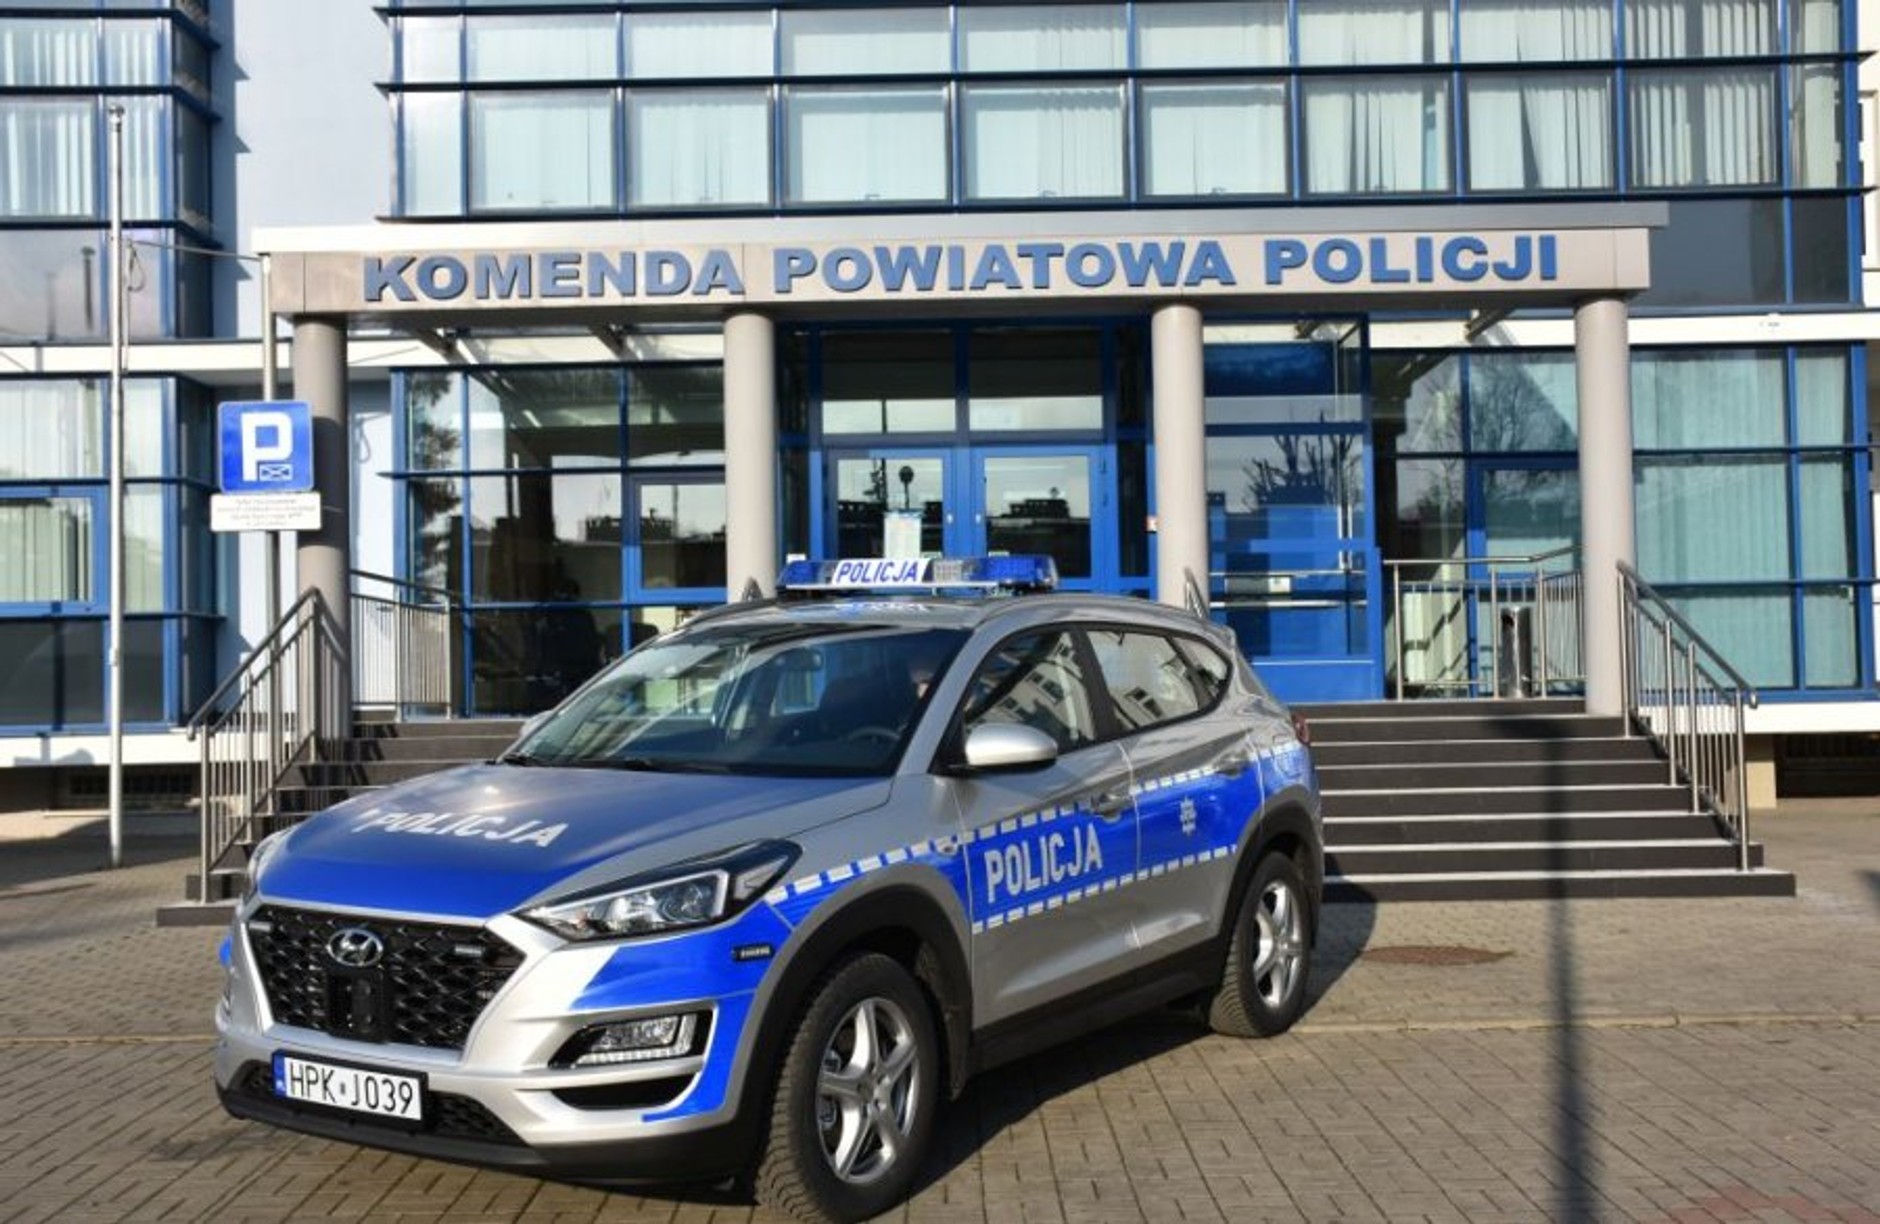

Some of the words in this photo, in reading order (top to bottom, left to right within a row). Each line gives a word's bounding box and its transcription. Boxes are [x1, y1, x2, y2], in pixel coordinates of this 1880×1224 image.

[363, 249, 745, 301] KOMENDA
[773, 240, 1237, 294] POWIATOWA
[1264, 235, 1557, 285] POLICJI
[241, 411, 293, 482] P
[837, 562, 919, 582] POLICJA
[353, 808, 567, 847] POLICJA
[984, 823, 1103, 904] POLICJA
[290, 1062, 336, 1103] HPK
[351, 1073, 413, 1114] J039
